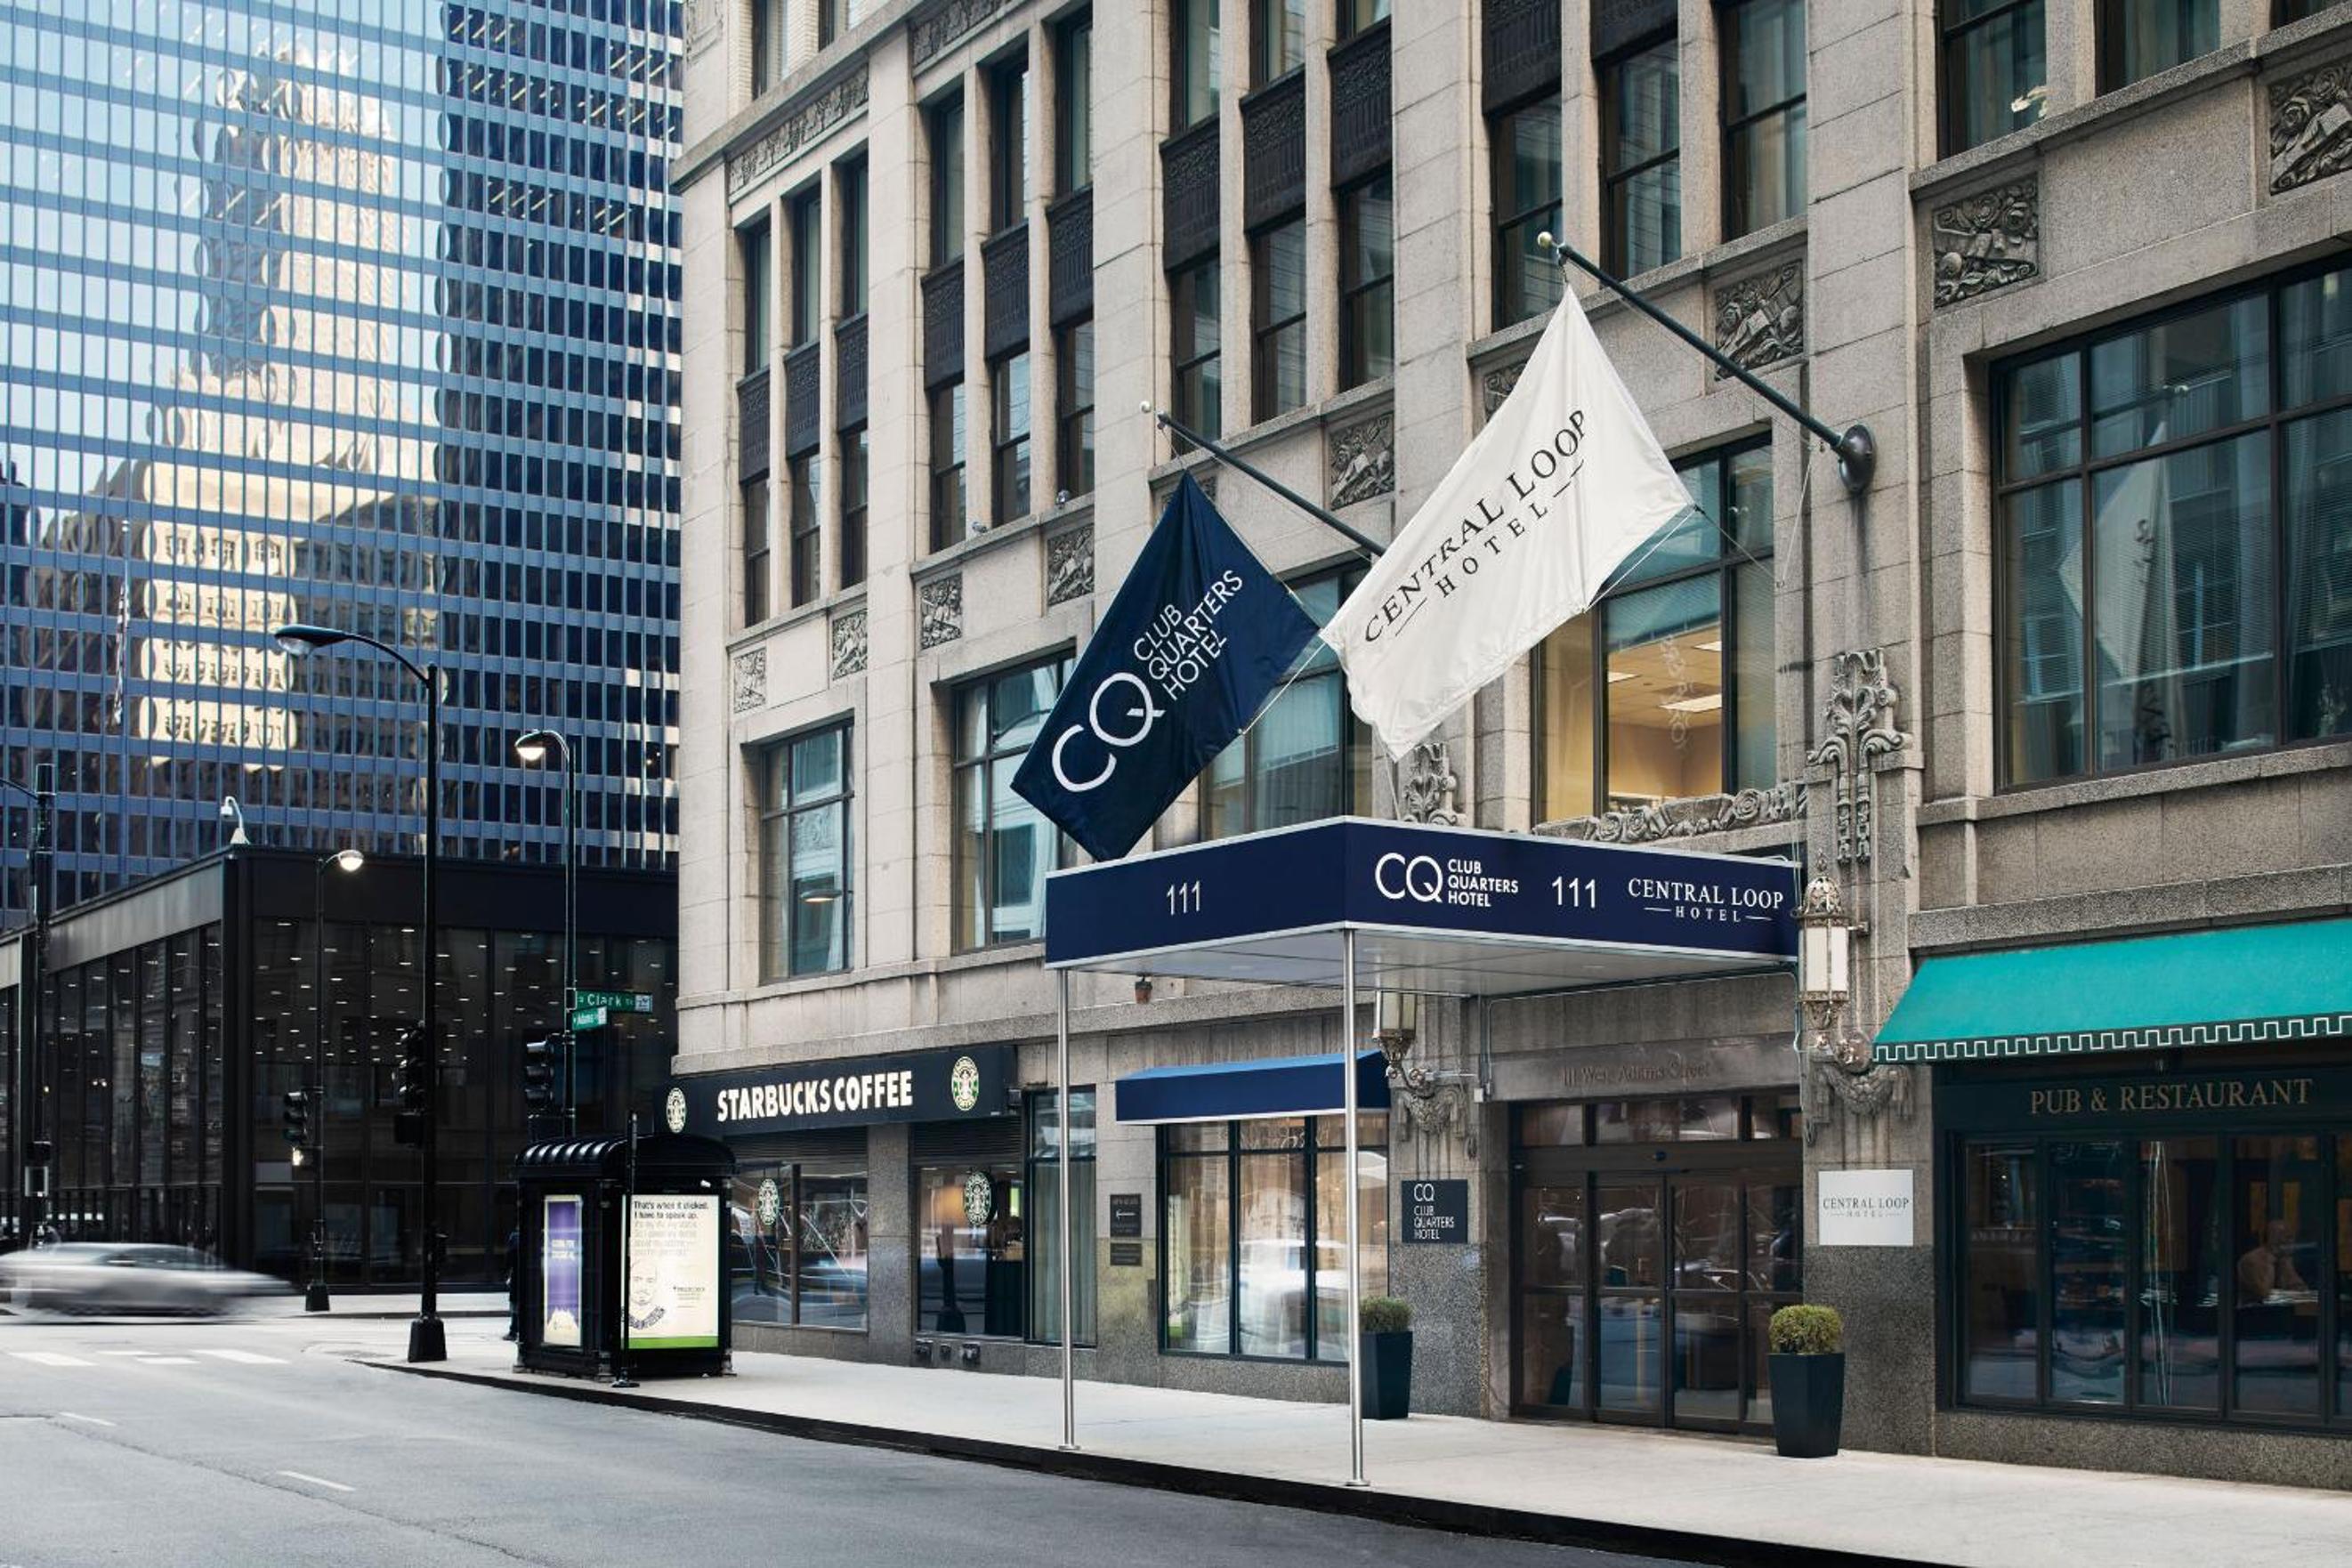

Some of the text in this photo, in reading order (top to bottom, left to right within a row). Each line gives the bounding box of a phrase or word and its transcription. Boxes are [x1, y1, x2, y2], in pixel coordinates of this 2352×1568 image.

[1365, 410, 1585, 643] CENTRAL LOOP
[1435, 502, 1548, 597] HOTEL
[1134, 604, 1182, 660] CLUB
[1149, 570, 1243, 680] QUARTERS
[1162, 629, 1227, 701] HOTEL
[1052, 672, 1166, 792] CQ
[1375, 853, 1443, 903] CQ
[1447, 859, 1483, 876] CLUB
[1447, 874, 1519, 893] QUARTERS
[1167, 880, 1200, 915] 111
[1448, 892, 1492, 908] HOTEL
[1551, 876, 1597, 909] 111
[1628, 877, 1784, 909] CENTRAL LOOP
[1674, 905, 1742, 923] HOTEL
[587, 993, 621, 1006] Clark
[717, 1079, 830, 1122] STARBUCKS
[834, 1071, 913, 1112] COFFEE
[2031, 1079, 2313, 1113] PUB & RESTAURANT
[1413, 1183, 1435, 1202] CQ
[1823, 1197, 1910, 1209] CENTRAL LOOP
[1413, 1205, 1435, 1216] CLUB
[1413, 1216, 1455, 1228] QUARTERS
[1413, 1229, 1440, 1240] HOTEL
